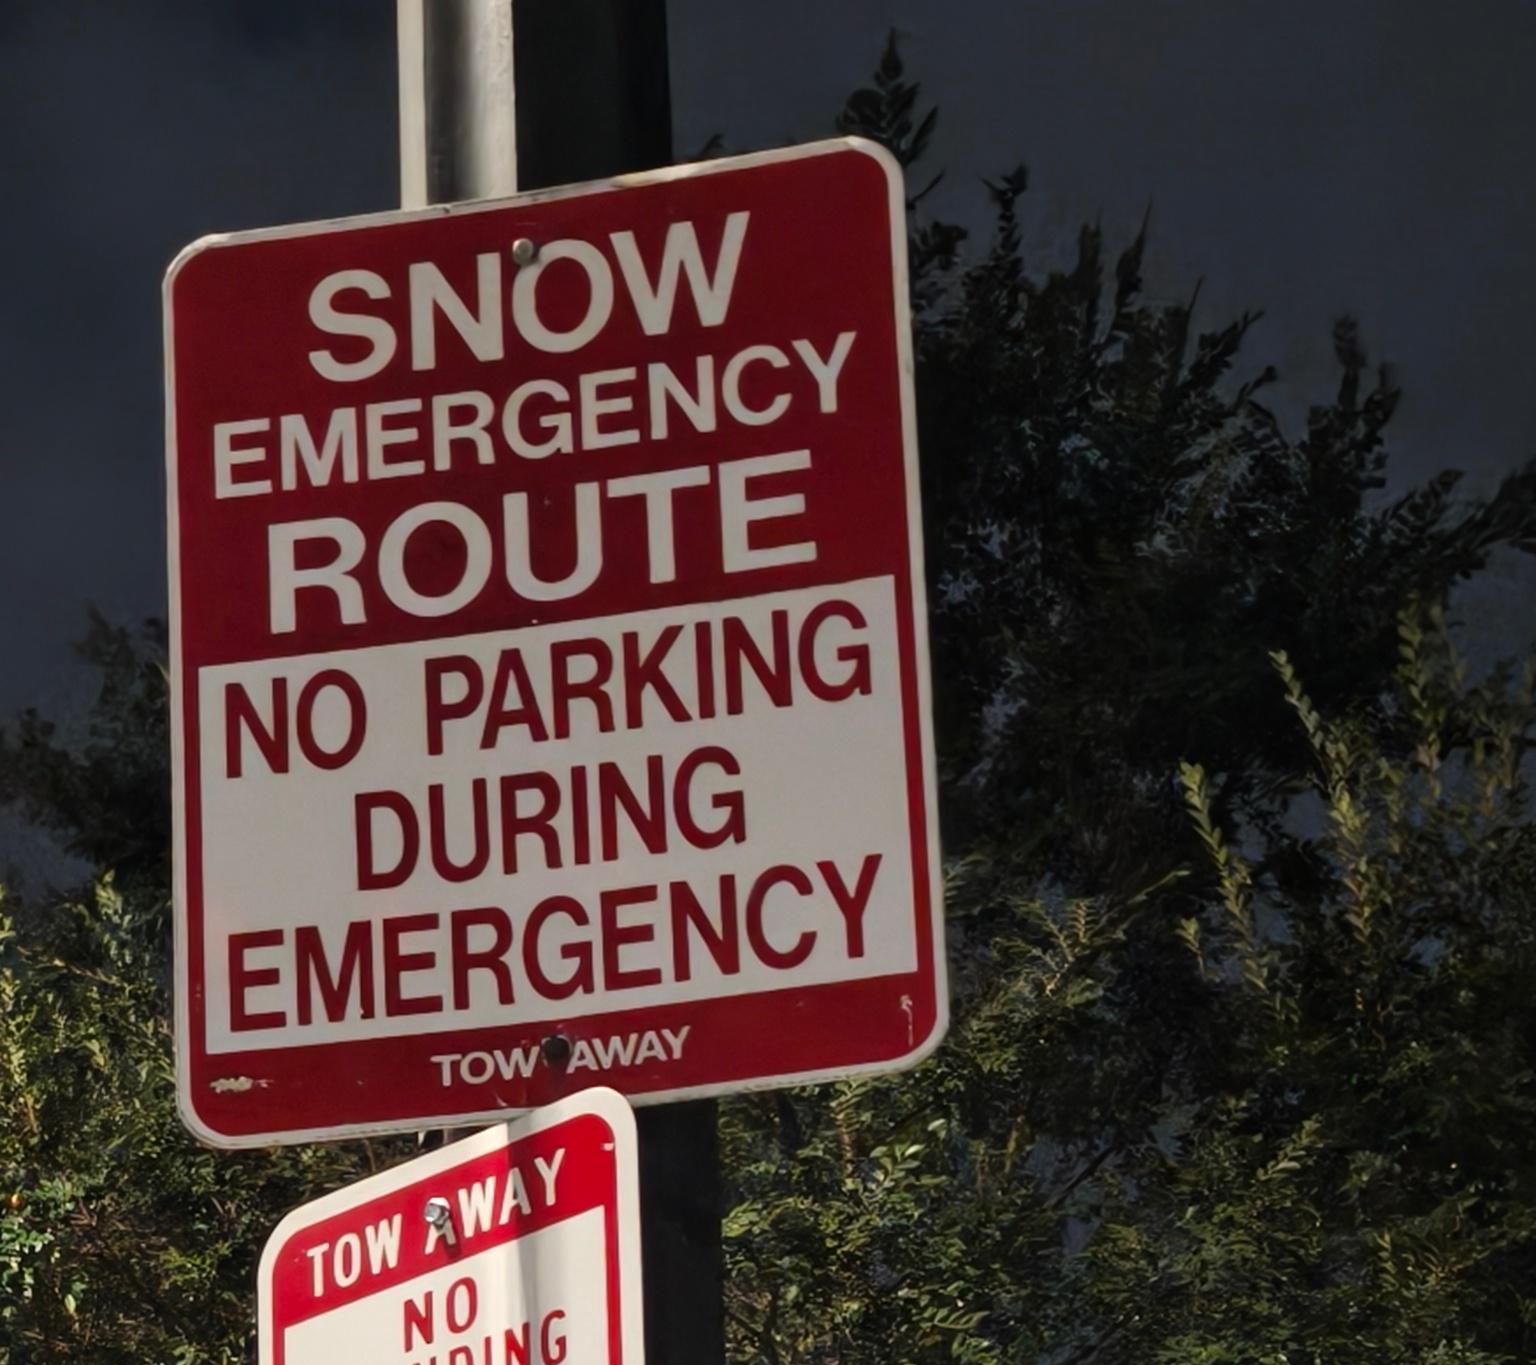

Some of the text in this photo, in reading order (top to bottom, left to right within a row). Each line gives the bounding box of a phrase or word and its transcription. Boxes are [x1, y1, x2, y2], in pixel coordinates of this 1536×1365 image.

[308, 211, 750, 382] SNOW
[213, 331, 856, 498] EMERGENCY
[267, 449, 818, 635] ROUTE
[224, 600, 873, 778] NO PARKING
[354, 747, 746, 892] DURING
[227, 854, 883, 1033] EMERGENCY
[430, 1025, 690, 1087] TOW AWAY
[306, 1147, 565, 1296] TOW AWAY
[403, 1276, 478, 1353] NO
